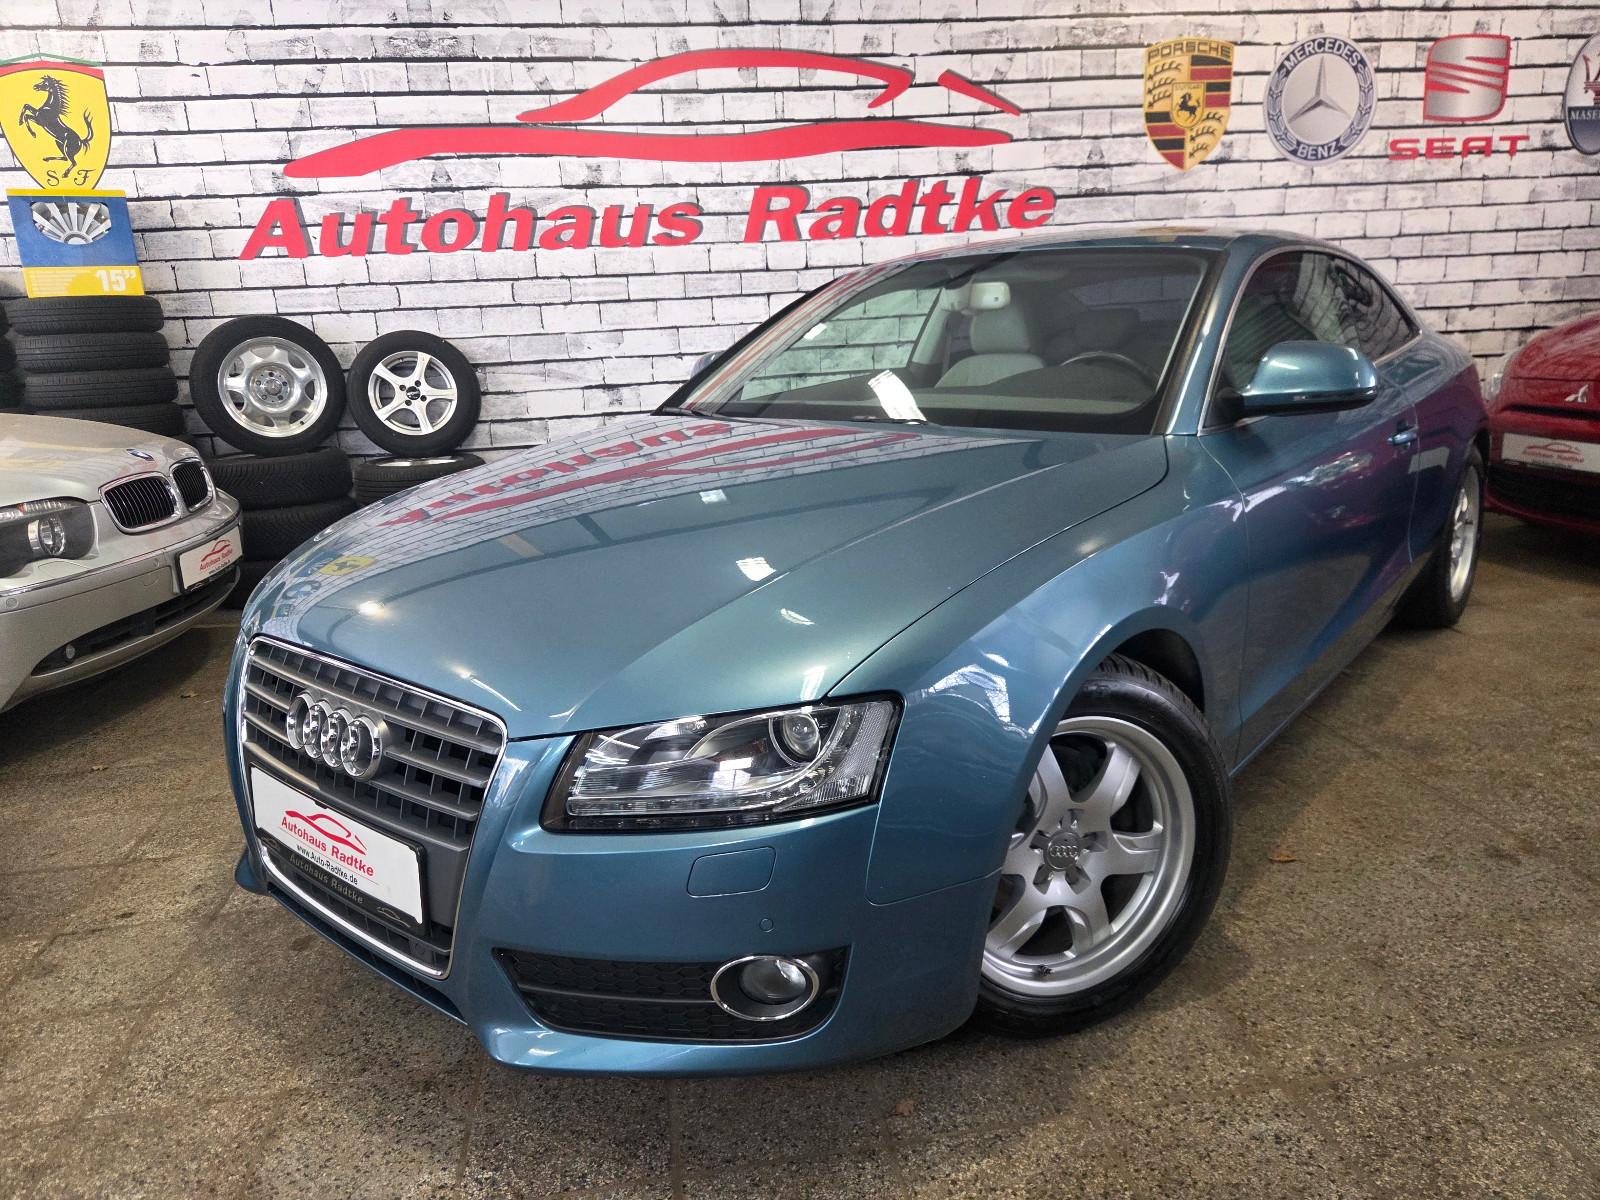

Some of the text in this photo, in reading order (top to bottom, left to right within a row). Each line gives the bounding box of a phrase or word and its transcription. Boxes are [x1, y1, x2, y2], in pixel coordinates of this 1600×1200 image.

[1147, 40, 1232, 64] PORSCHE
[1282, 38, 1361, 70] MERCEDES
[1296, 141, 1340, 160] BENZ
[1388, 135, 1530, 160] SEAT
[46, 168, 97, 187] S F
[239, 176, 1057, 261] Autohaus Radtke
[281, 816, 374, 876] Autohaus Radtke
[290, 853, 364, 905] Autohaus Radtke
[296, 844, 359, 886] www.Auto-Radtke.de
